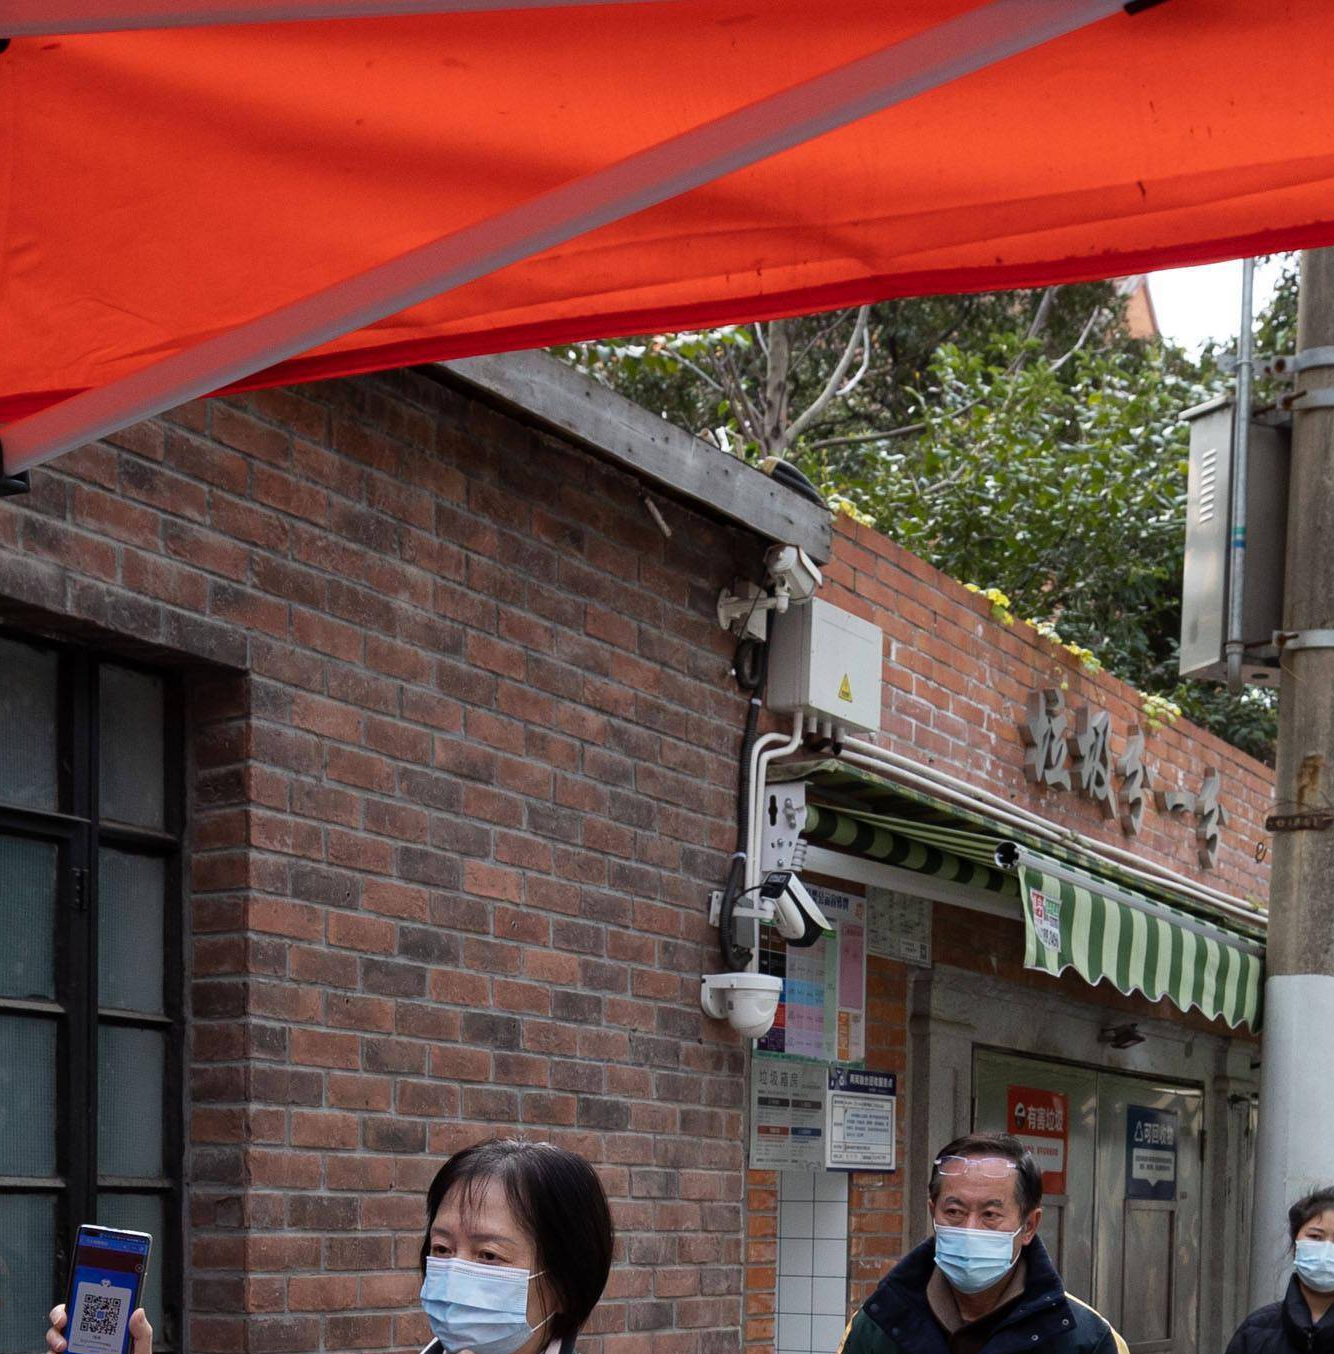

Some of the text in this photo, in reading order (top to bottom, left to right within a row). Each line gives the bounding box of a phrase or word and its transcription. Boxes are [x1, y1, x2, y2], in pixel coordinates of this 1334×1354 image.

[1019, 687, 1229, 870] 垃圾分一分
[758, 1068, 800, 1088] 垃圾箱房
[1026, 1104, 1064, 1132] 有害垃圾
[1143, 1123, 1174, 1146] 可回收物
